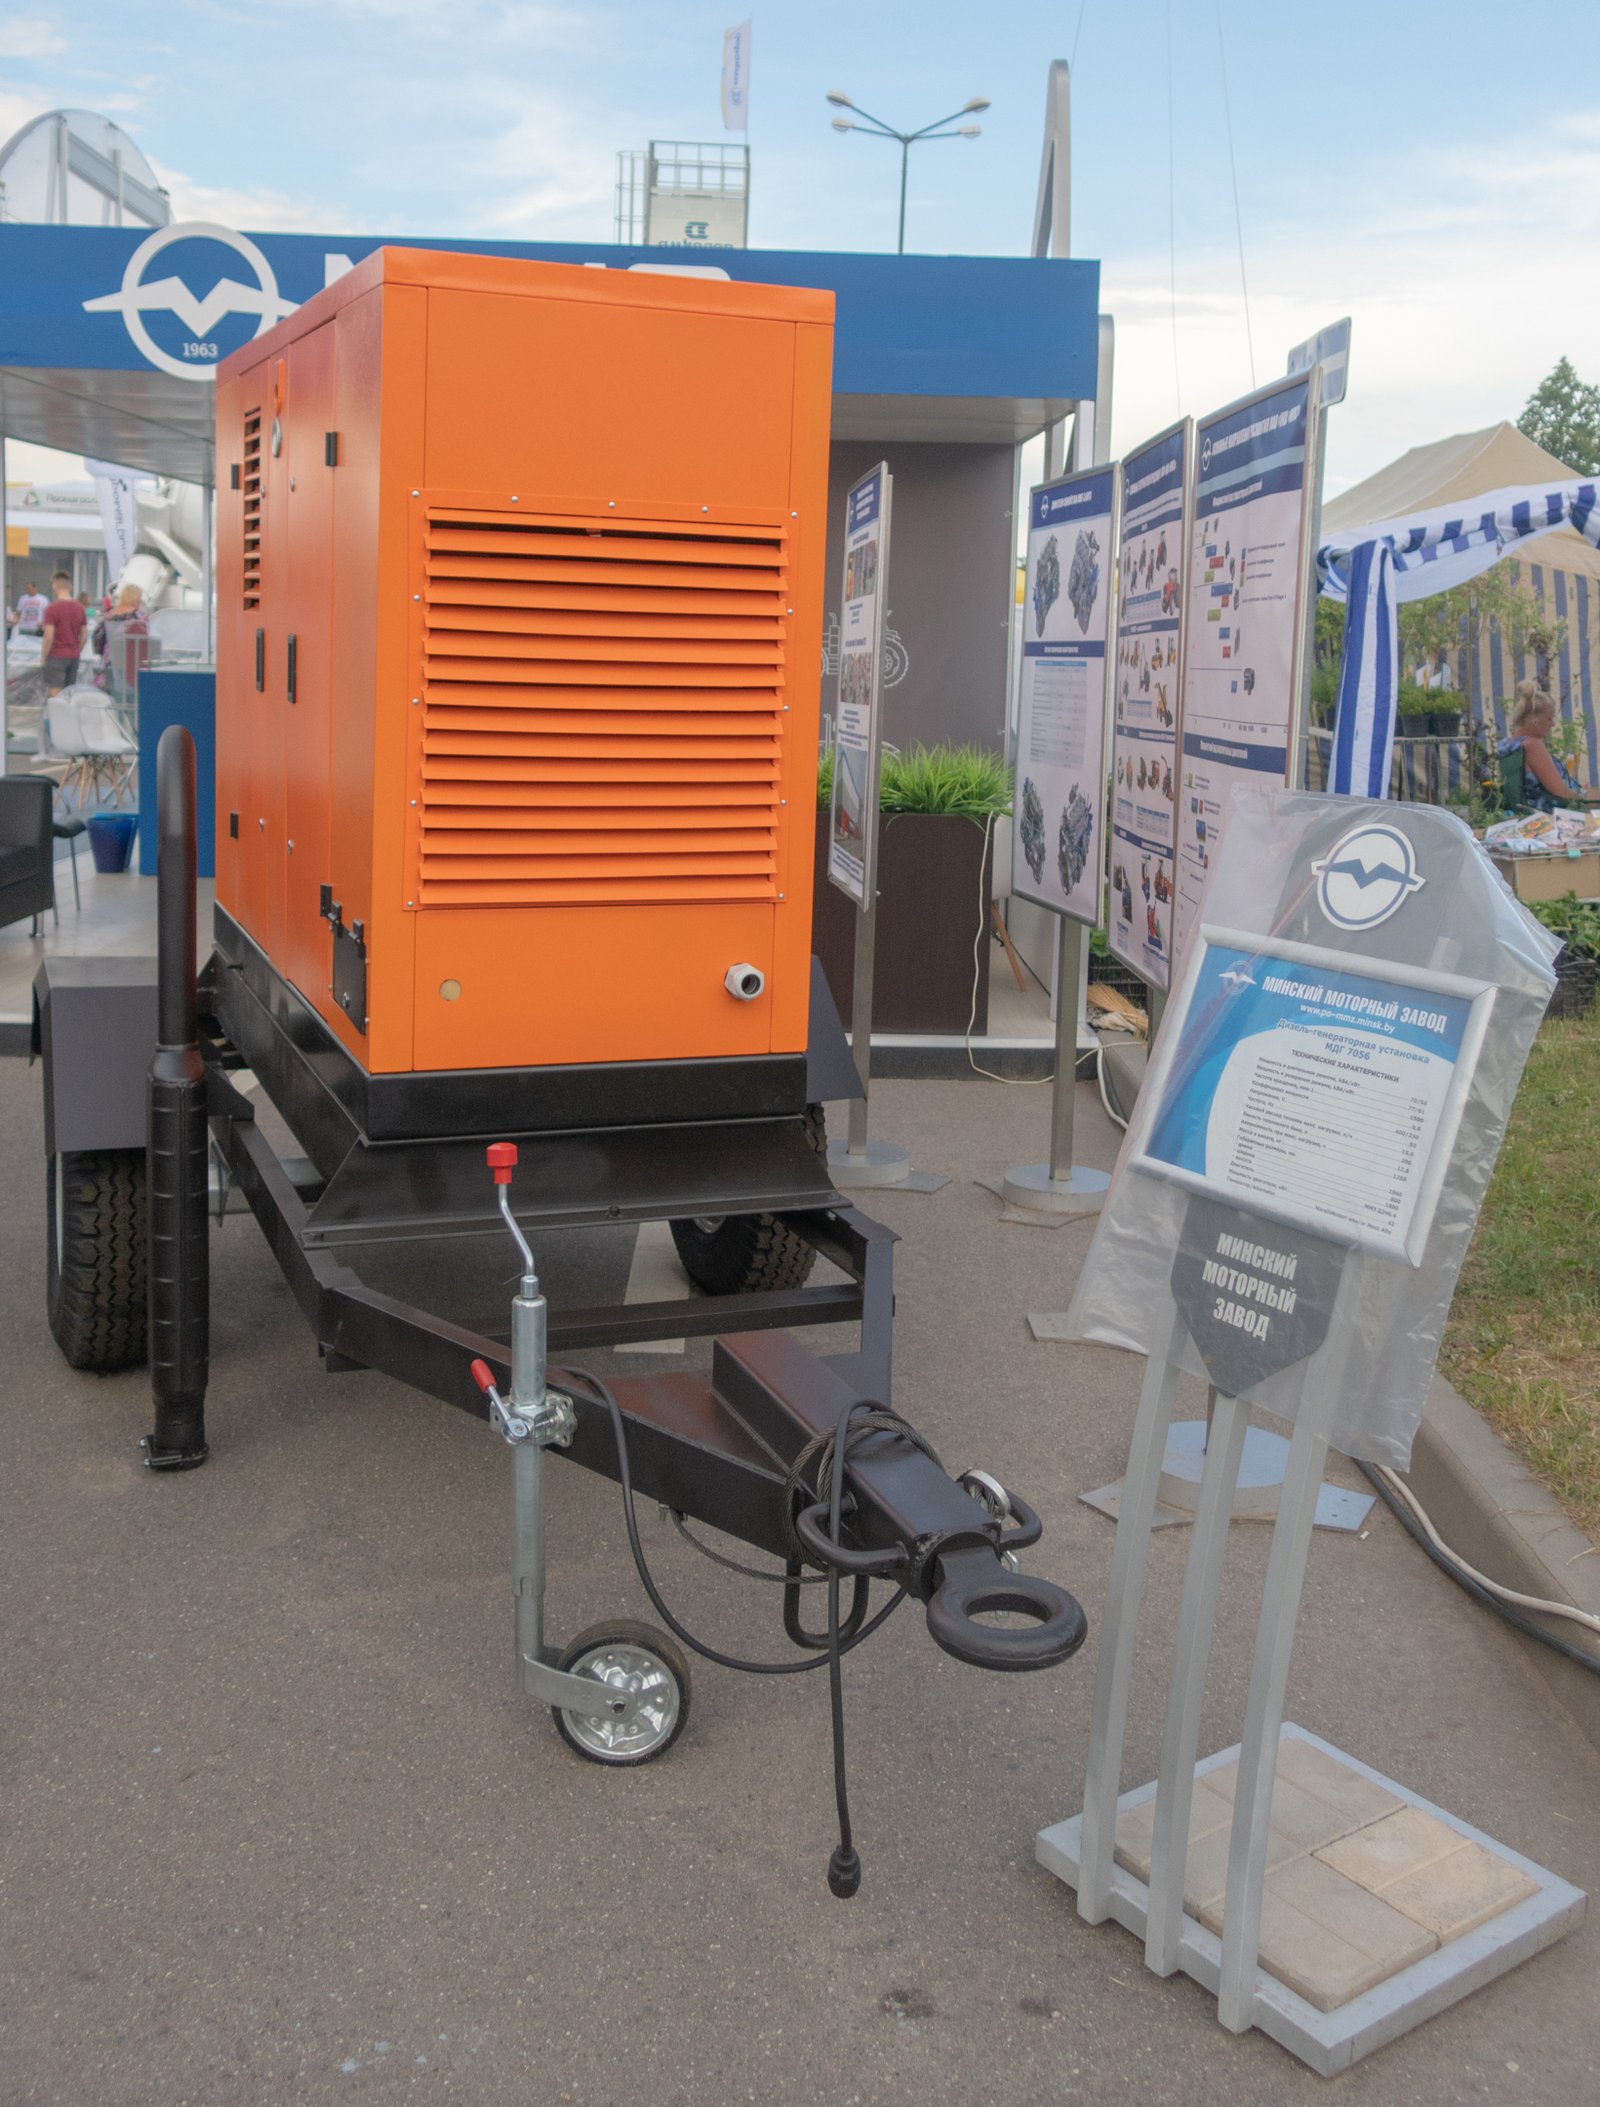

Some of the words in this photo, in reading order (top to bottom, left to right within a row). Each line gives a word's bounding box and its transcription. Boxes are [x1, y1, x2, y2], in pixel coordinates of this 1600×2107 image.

[183, 342, 218, 359] 1963
[1261, 975, 1322, 1002] МИНСКИЙ
[1323, 988, 1398, 1020] МОТОРНЫЙ
[1398, 1006, 1447, 1033] ЗАВОД
[1299, 1004, 1395, 1033] www.po-mmz.minsk.by
[1277, 1019, 1376, 1050] Дизель-генераторная
[1378, 1046, 1429, 1064] установка
[1324, 1042, 1345, 1055] МДГ
[1346, 1047, 1370, 1060] 7056
[1290, 1049, 1336, 1067] ТЕХНИЧЕСКИЕ
[1336, 1061, 1400, 1083] ХАРАКТЕРИСТИКИ
[1216, 1232, 1297, 1281] МИНСКИЙ
[1202, 1260, 1297, 1315] МОТОРНЫЙ
[1213, 1297, 1270, 1341] ЗАВОД
